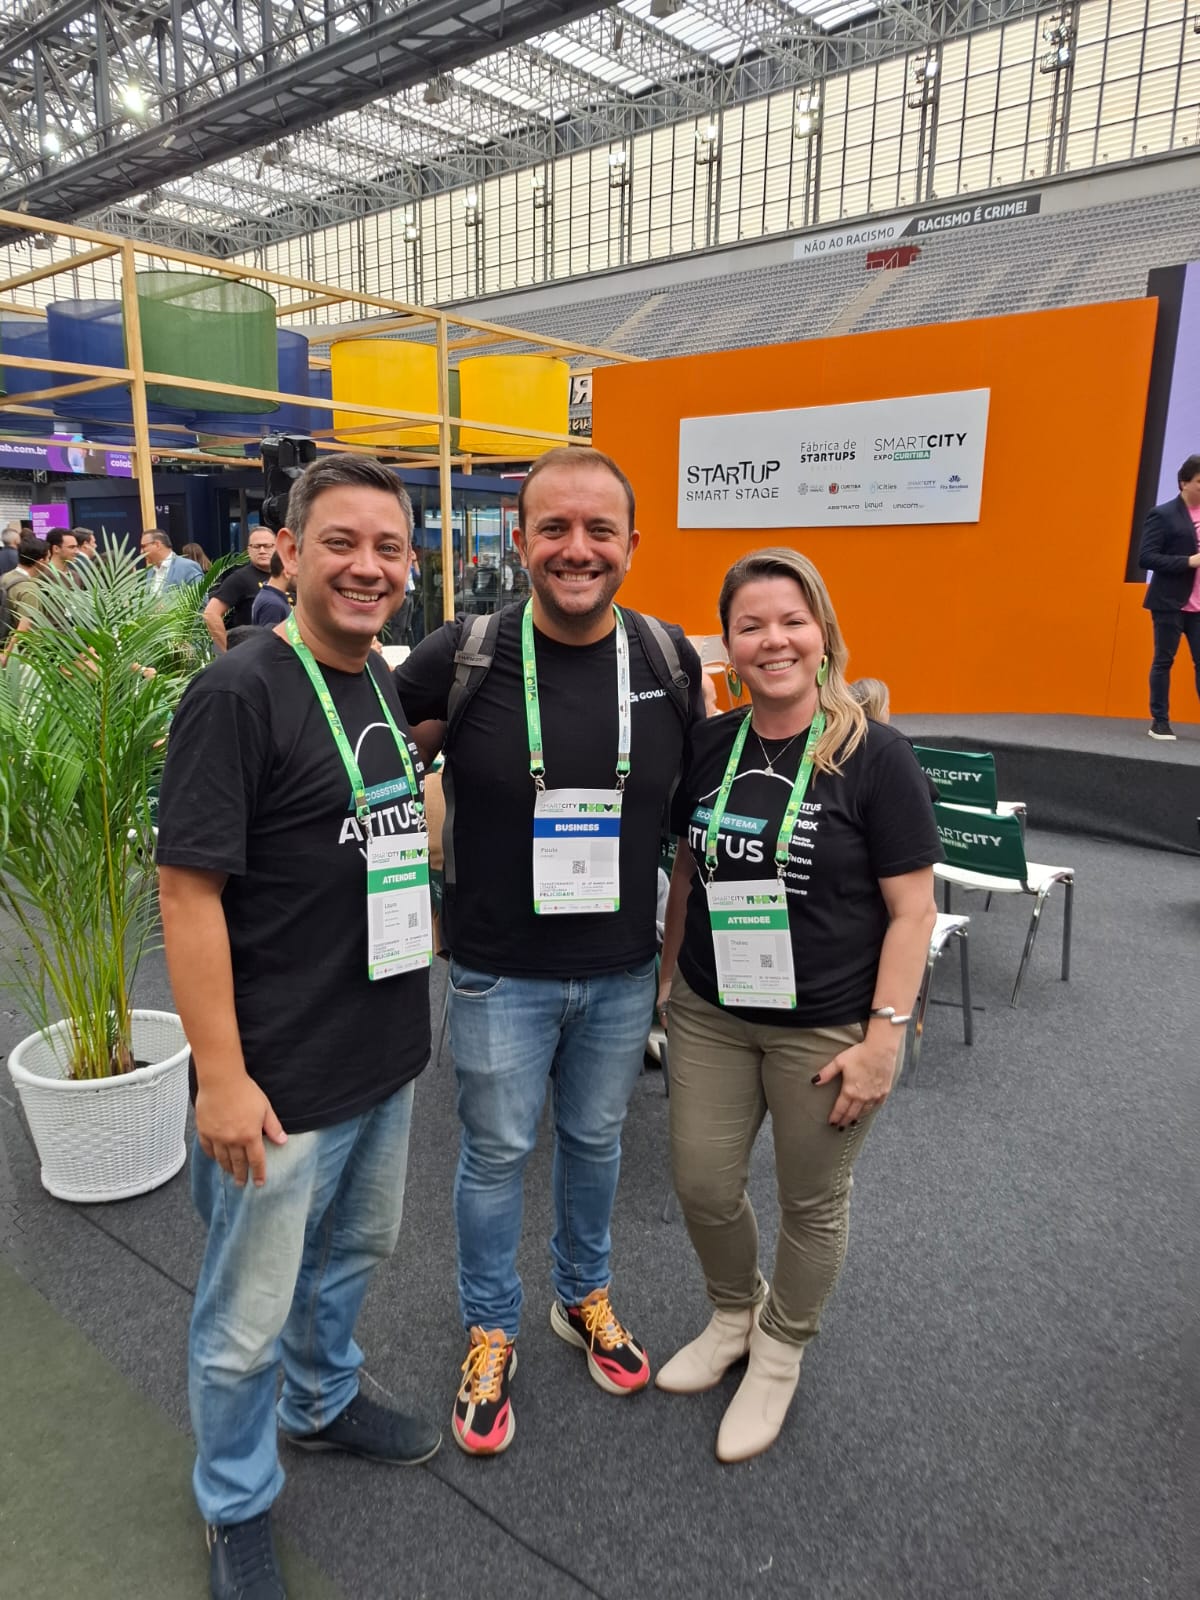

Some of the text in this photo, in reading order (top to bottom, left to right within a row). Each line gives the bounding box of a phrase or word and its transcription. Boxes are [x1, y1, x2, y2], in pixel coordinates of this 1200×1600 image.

[917, 200, 1028, 233] RACISMO É CRIME!
[804, 226, 895, 254] NÃO AO RACISMO
[800, 438, 857, 452] Fábrica de
[874, 432, 967, 452] SMARTCITY
[873, 451, 930, 461] EXPO CURITIBA
[687, 460, 781, 486] STARTUP
[686, 487, 779, 502] SMART STAGE
[921, 766, 982, 783] ARTCITY
[365, 781, 408, 802] COSSISTEMA
[555, 823, 600, 832] BUSINESS
[937, 825, 1002, 847] ARTCITY
[382, 871, 417, 885] ATTENDEE
[727, 916, 771, 924] ATTENDEE
